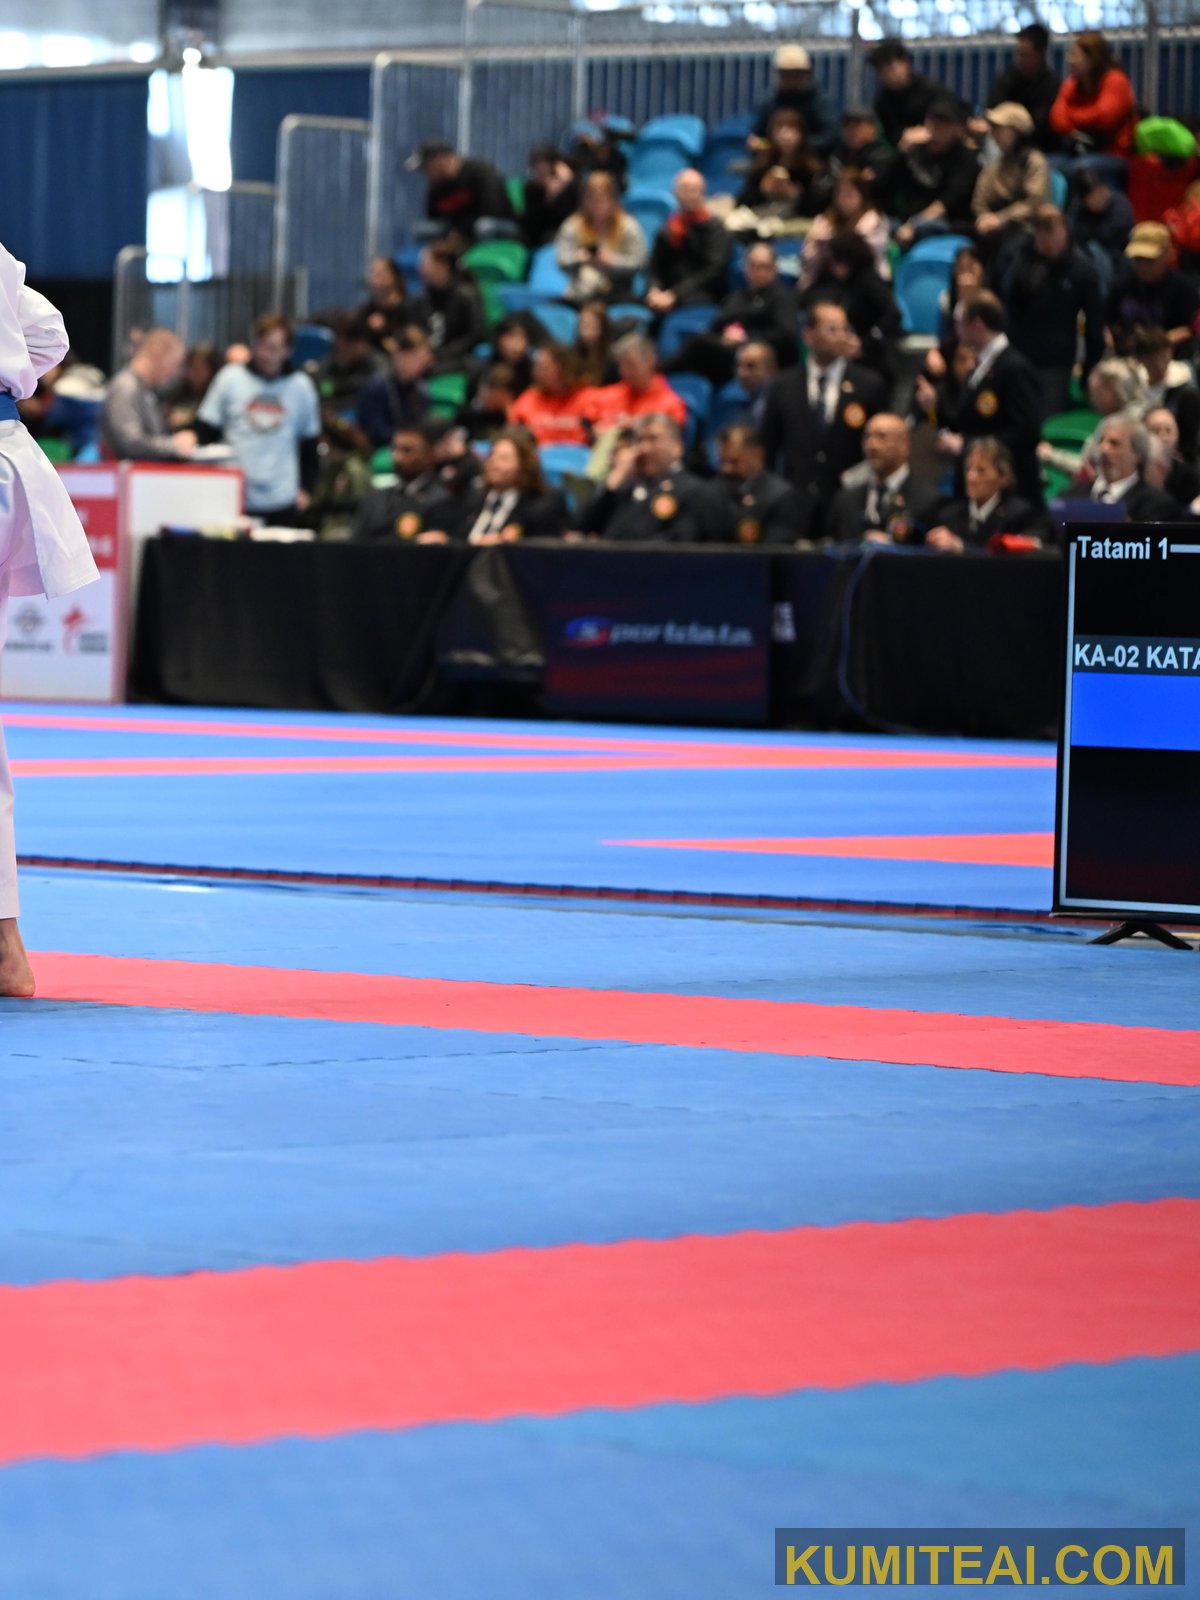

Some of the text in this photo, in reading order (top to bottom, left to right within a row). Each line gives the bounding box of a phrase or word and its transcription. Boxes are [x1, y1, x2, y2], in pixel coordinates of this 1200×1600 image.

[1077, 535, 1168, 560] Tatami 1
[1074, 643, 1140, 669] KA-02
